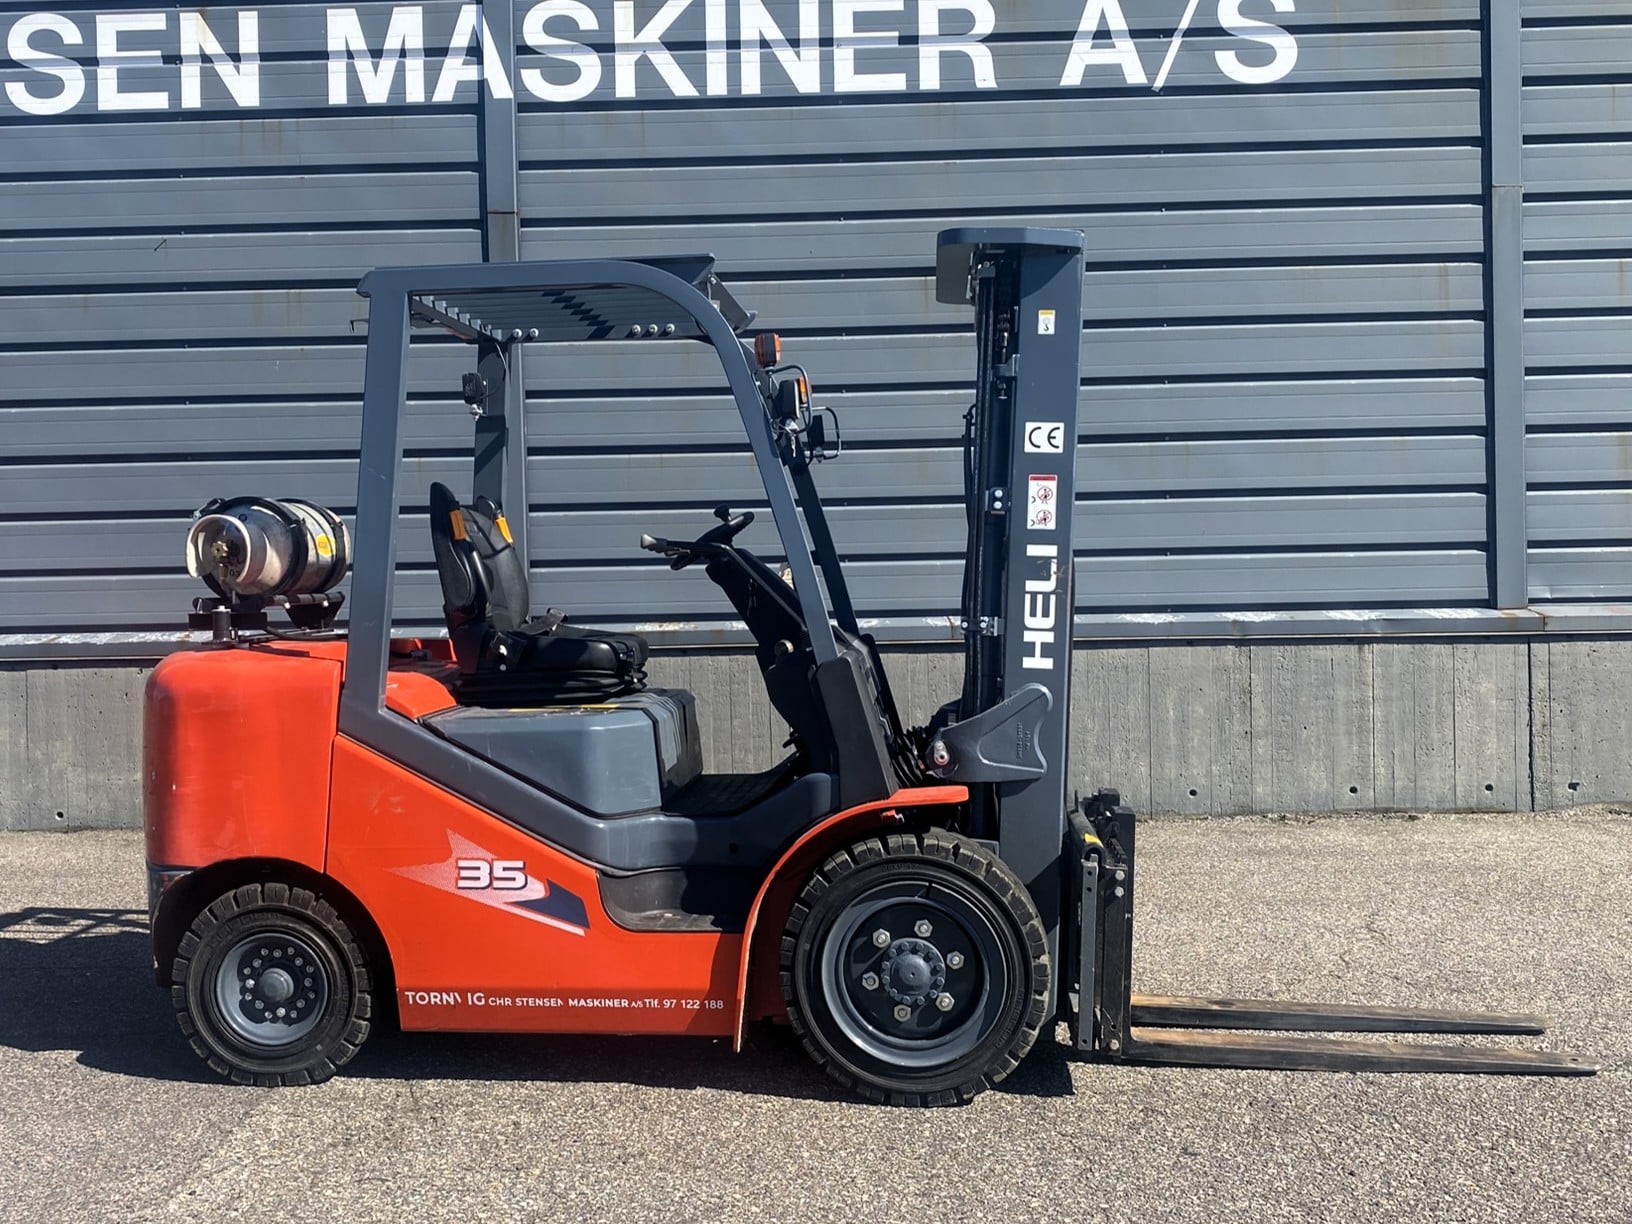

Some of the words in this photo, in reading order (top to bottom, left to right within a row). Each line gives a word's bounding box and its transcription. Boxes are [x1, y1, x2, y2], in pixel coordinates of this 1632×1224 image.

[327, 0, 998, 105] MASKINER
[1059, 0, 1299, 92] A/S
[1028, 426, 1061, 449] CE
[1022, 543, 1058, 670] HELI
[456, 859, 527, 889] 35
[568, 998, 629, 1008] MASKINER
[644, 998, 661, 1008] Tlf.
[663, 999, 677, 1009] 97
[680, 999, 700, 1009] 122
[704, 999, 724, 1009] 188
